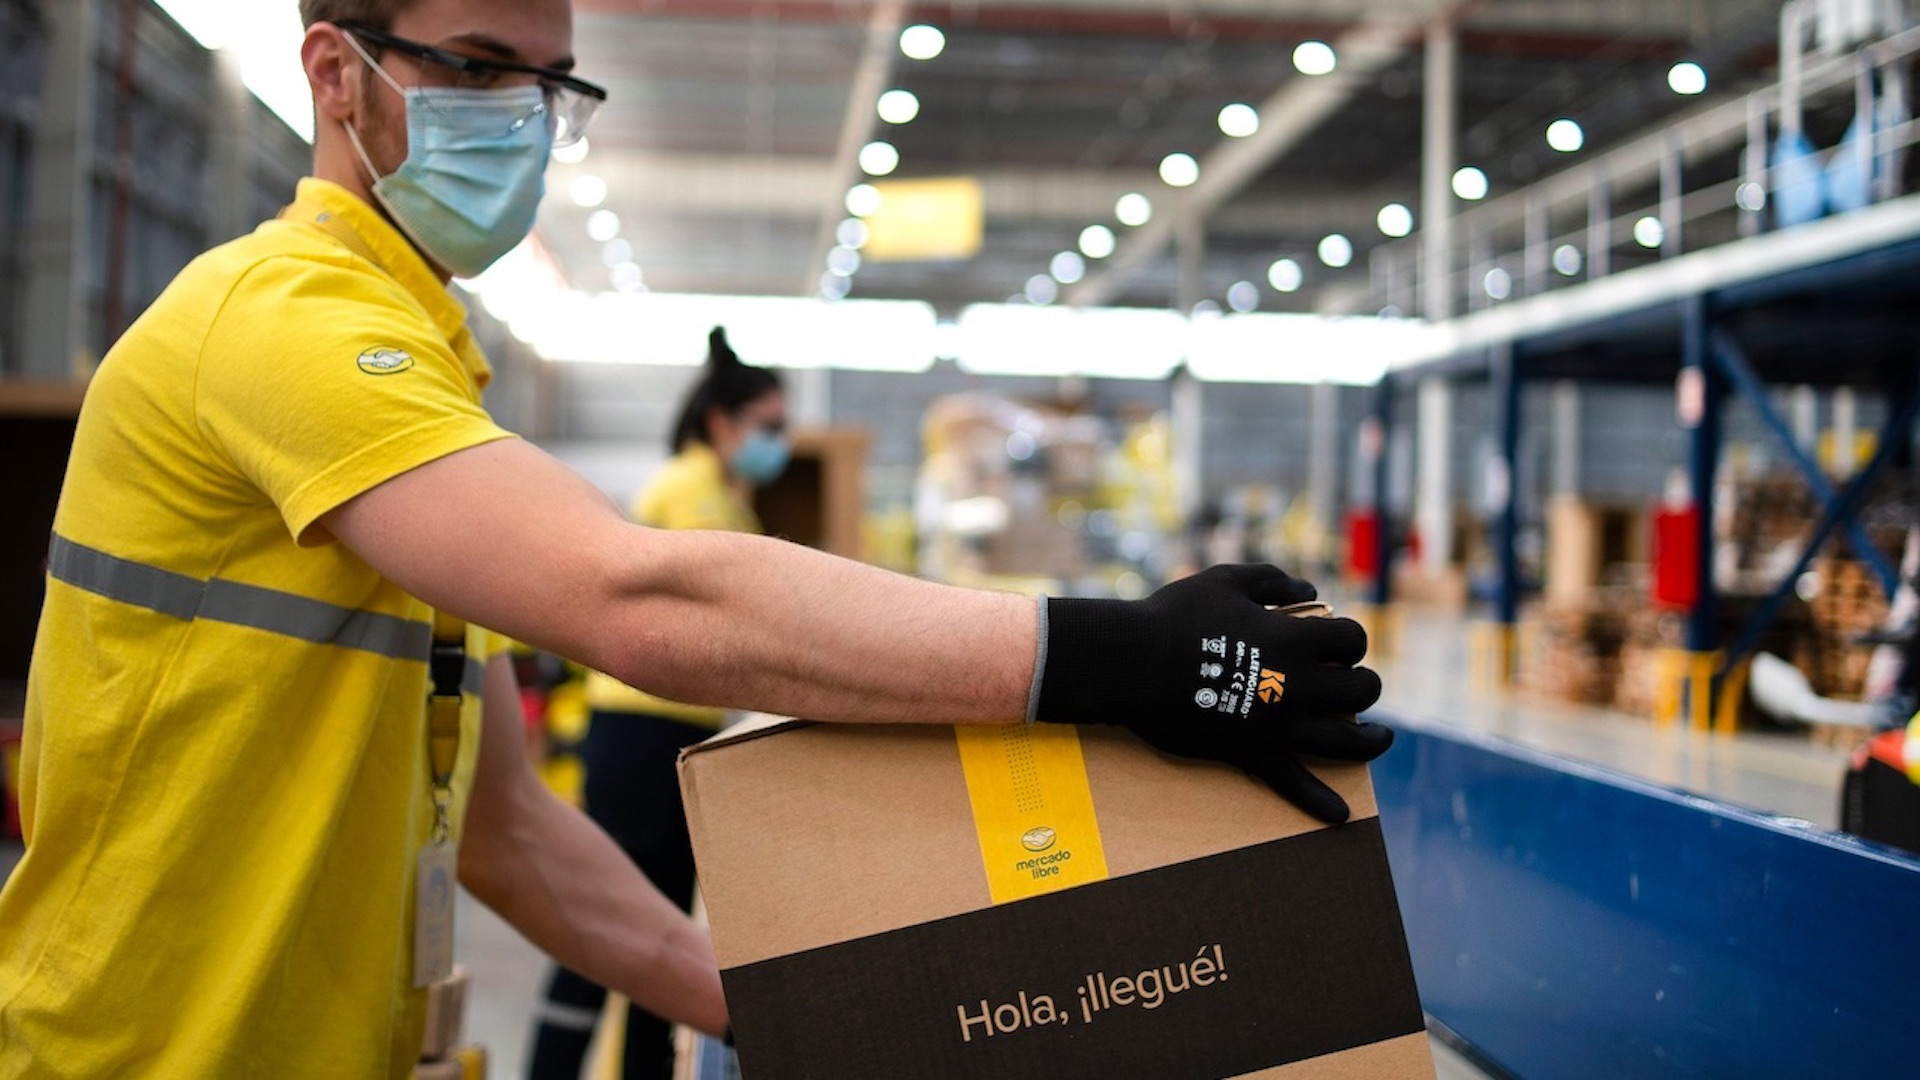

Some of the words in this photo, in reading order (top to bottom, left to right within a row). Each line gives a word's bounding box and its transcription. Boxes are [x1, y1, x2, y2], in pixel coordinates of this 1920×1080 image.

[1240, 647, 1260, 715] KLEENGUARD
[1016, 850, 1071, 871] mercado
[1032, 864, 1059, 879] libre
[956, 990, 1069, 1042] Hola,
[1076, 943, 1229, 1024] ¡llegué!
